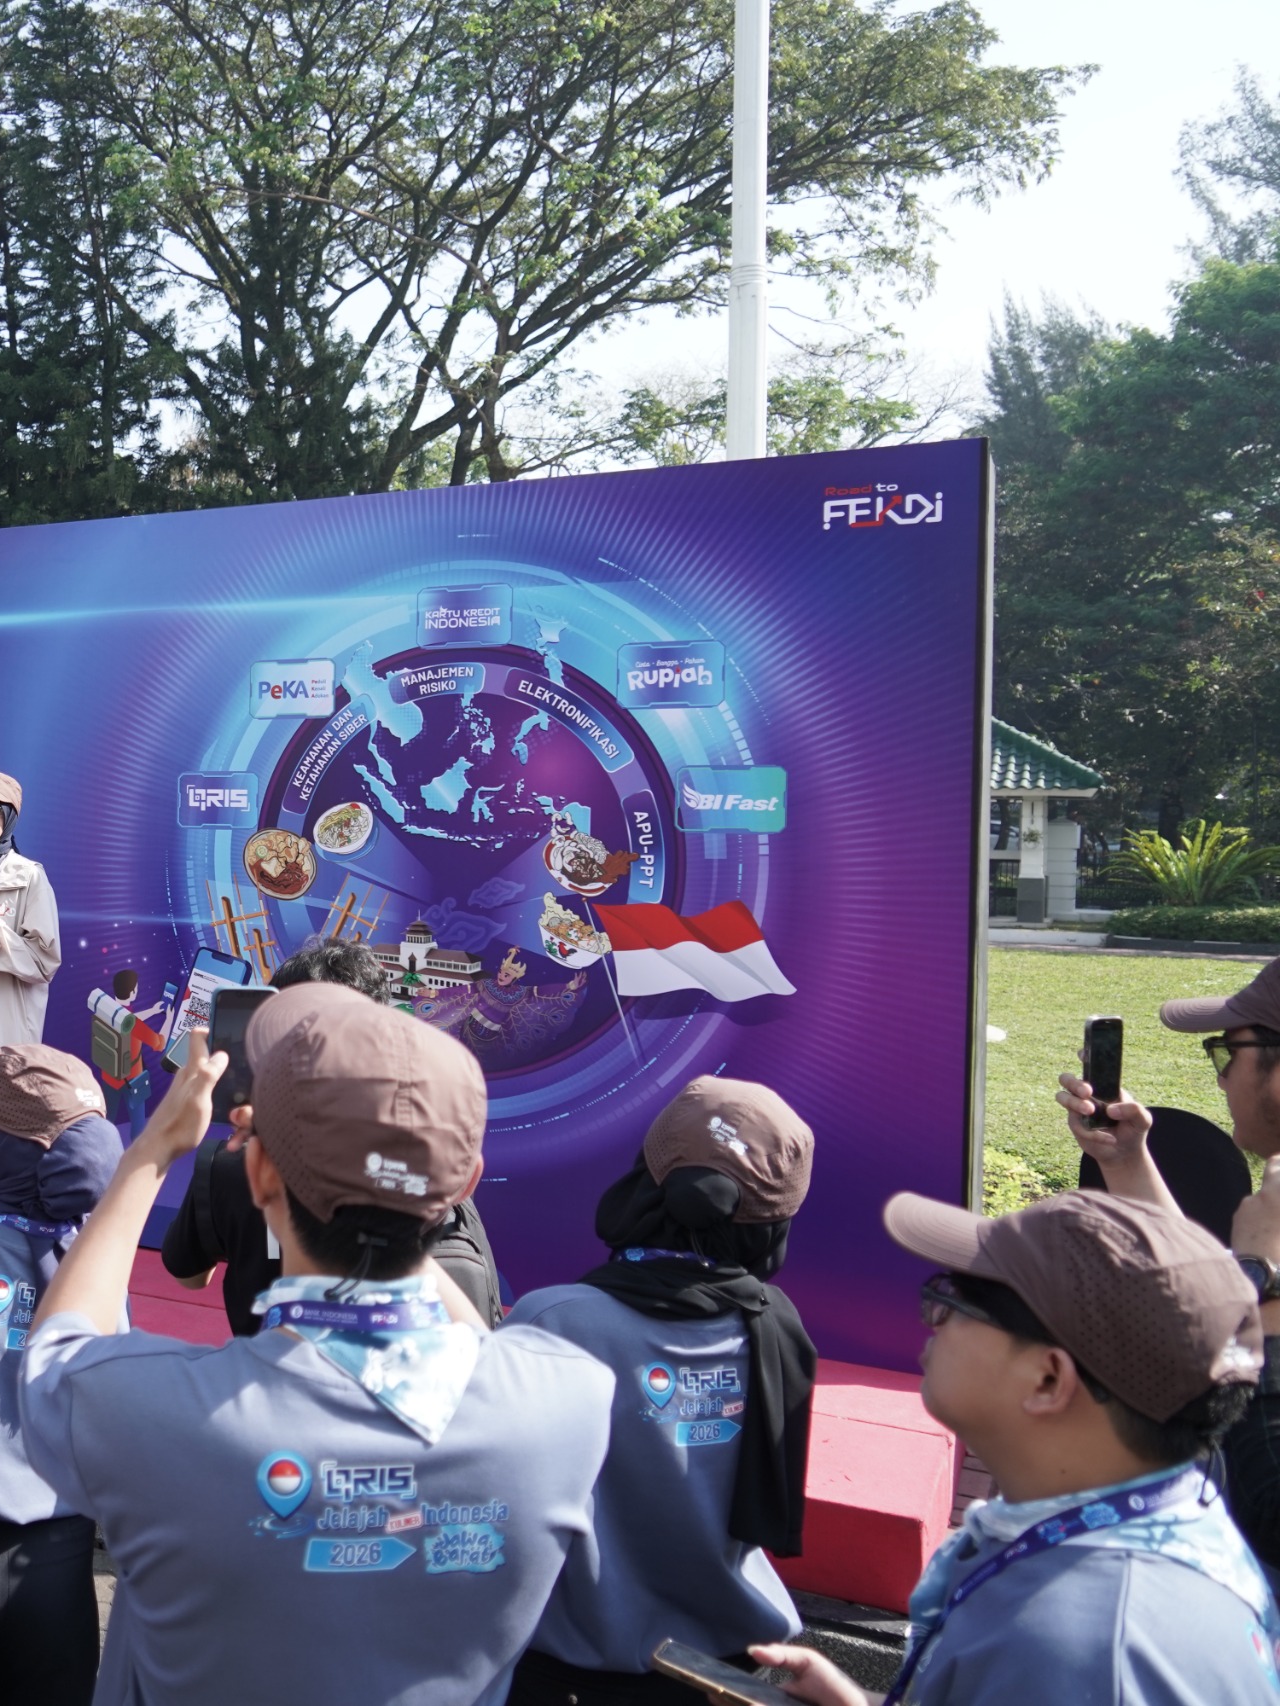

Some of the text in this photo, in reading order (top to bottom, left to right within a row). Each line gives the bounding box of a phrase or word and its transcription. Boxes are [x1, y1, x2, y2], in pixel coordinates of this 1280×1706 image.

[824, 483, 898, 496] Road to
[425, 607, 500, 619] KARTU KREDIT
[425, 616, 500, 629] INDONESIA
[258, 680, 309, 699] PeKA
[400, 666, 474, 688] MANAJEMEN
[419, 679, 457, 695] RISIKO
[627, 665, 713, 691] Rupiah
[518, 680, 620, 760] ELEKTRONIFIKASI
[292, 709, 353, 787] KEAMANAN DAN
[299, 713, 367, 801] KETAHANAN SIBER
[187, 785, 250, 811] QRIS
[723, 795, 779, 811] Fast
[633, 811, 655, 889] APU-PPT
[680, 1367, 741, 1396] QRIS
[680, 1397, 724, 1416] Jelajah
[690, 1423, 720, 1441] 2026
[320, 1461, 417, 1503] QRIS
[317, 1504, 390, 1533] Jelajah
[420, 1499, 510, 1526] Indonesia
[329, 1541, 383, 1567] 2026
